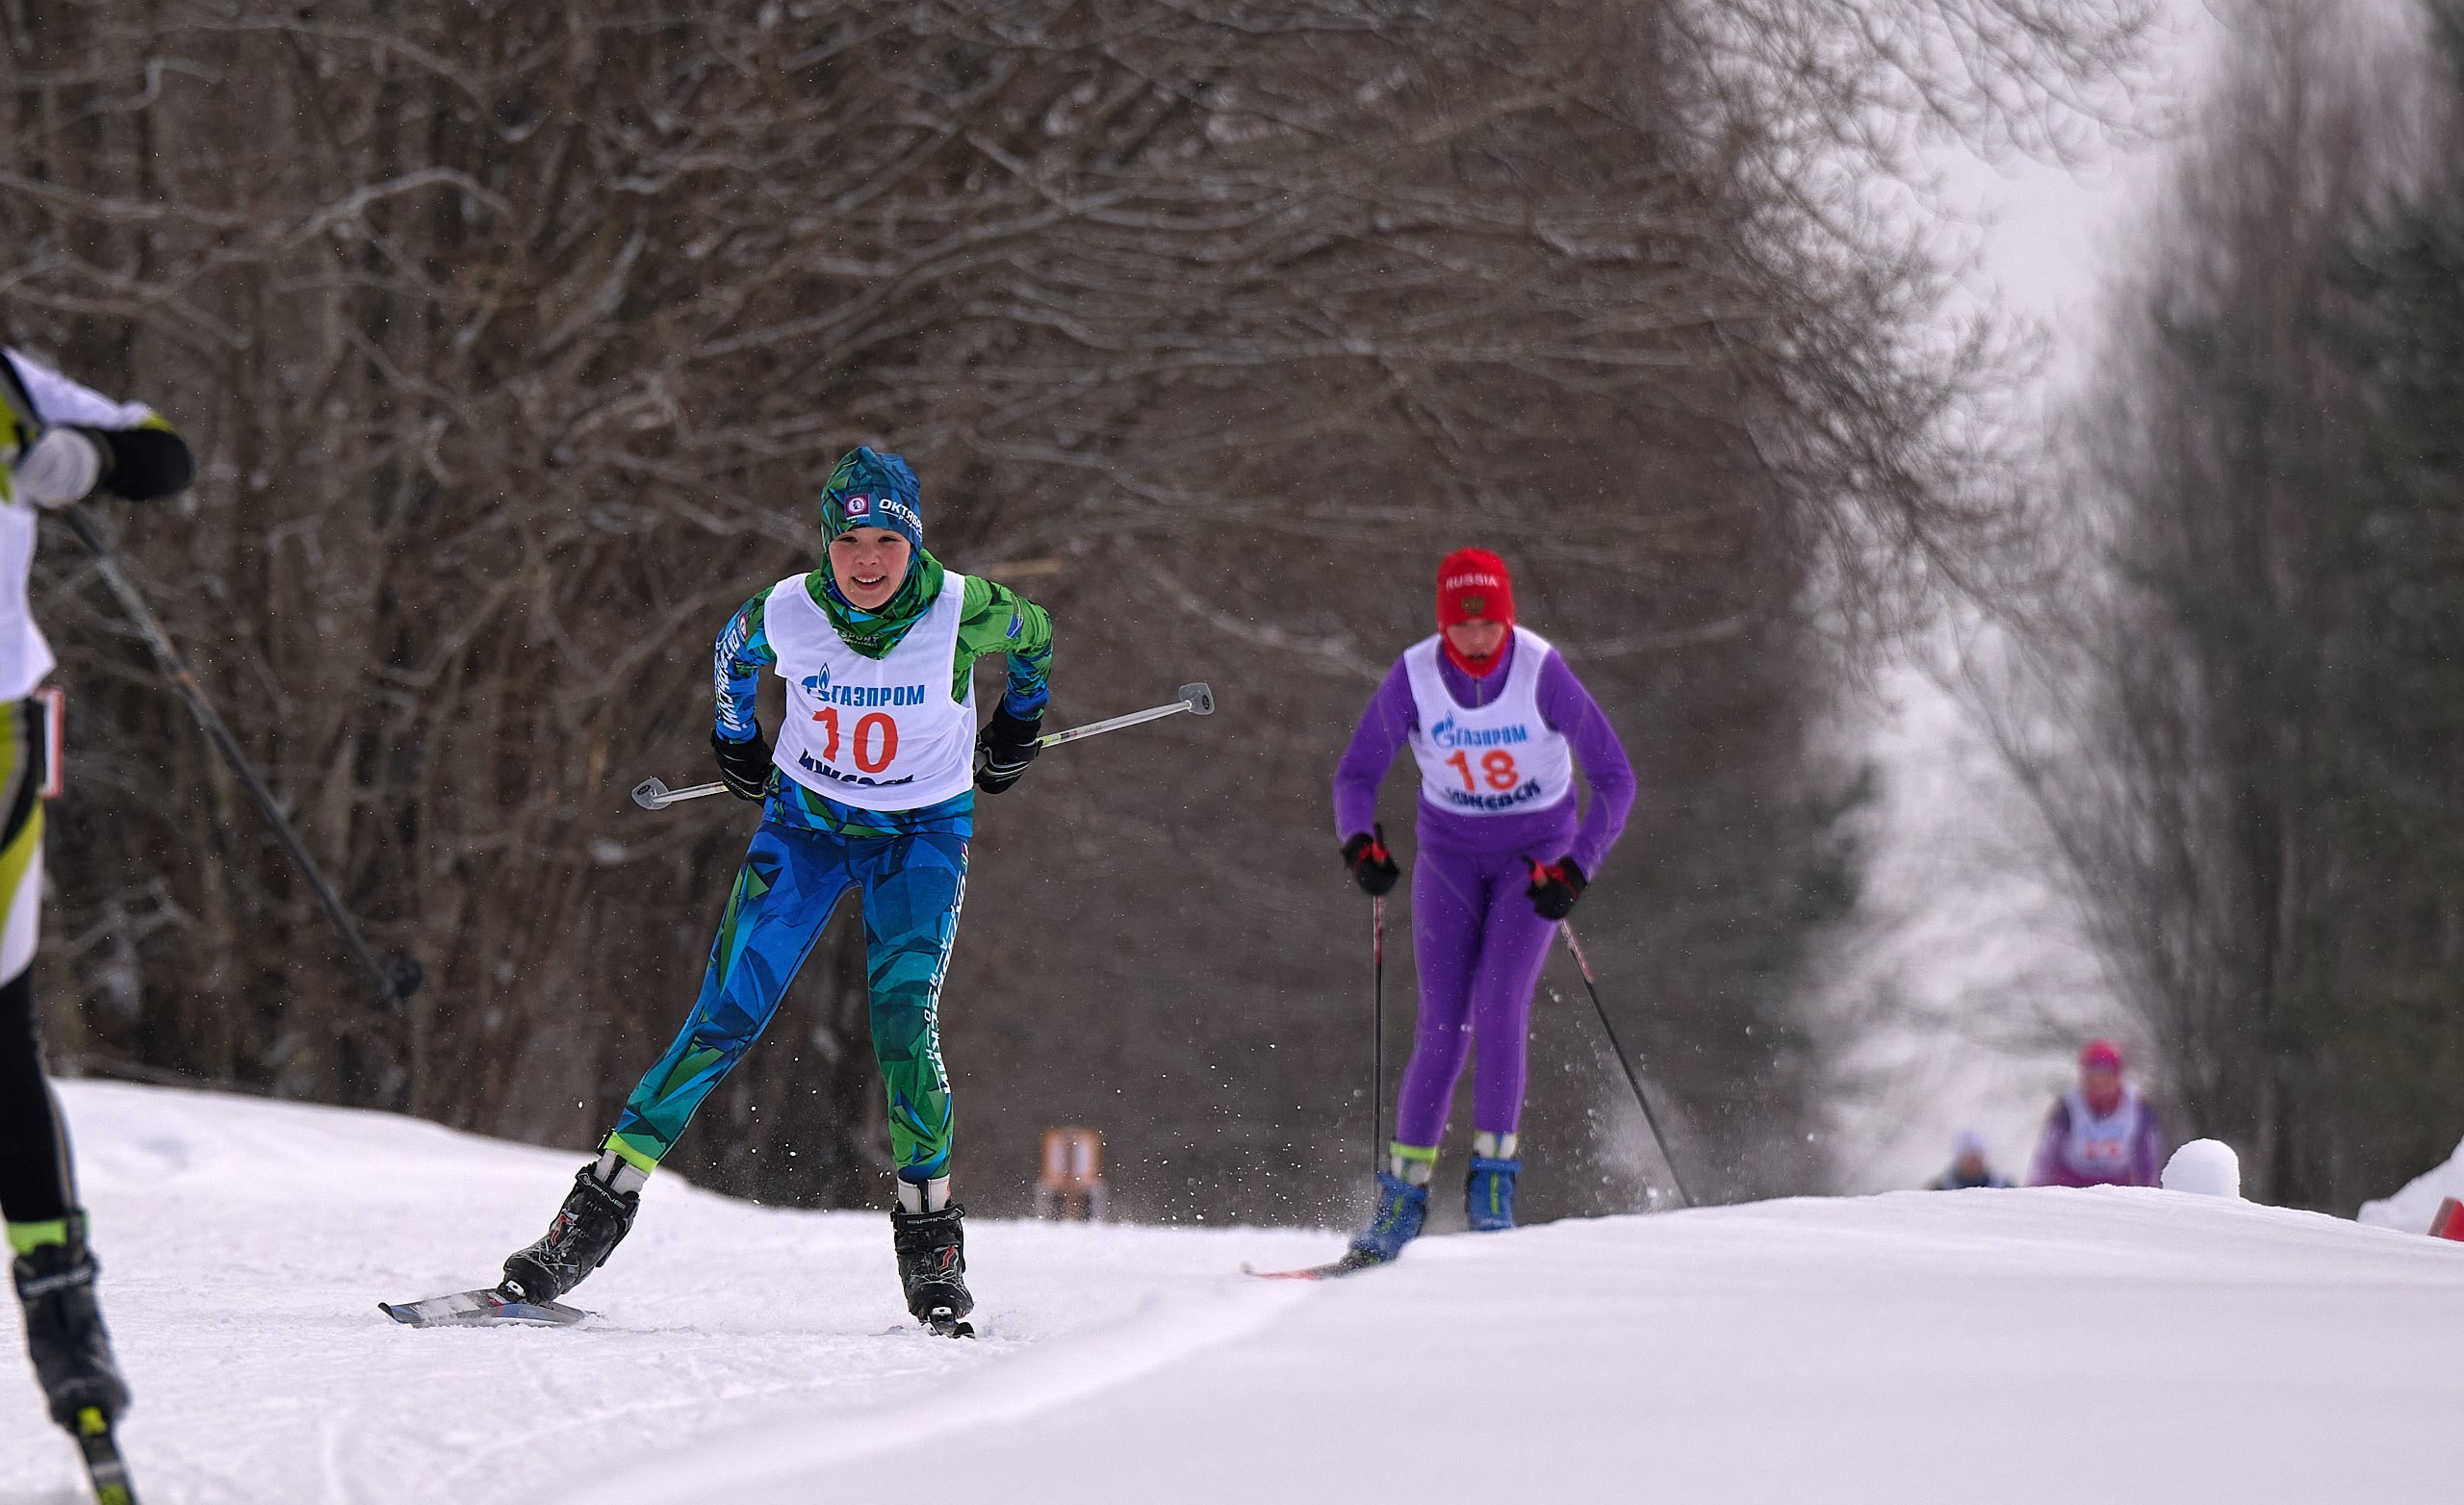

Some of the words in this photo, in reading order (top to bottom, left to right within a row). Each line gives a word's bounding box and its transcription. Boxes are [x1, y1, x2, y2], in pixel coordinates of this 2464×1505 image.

[1446, 573, 1498, 591] RUSSIA
[832, 684, 925, 706] ГАЗПРОМ
[811, 705, 899, 774] 10
[1455, 724, 1527, 746] ГАЗПРОМ
[1445, 749, 1519, 794] 18
